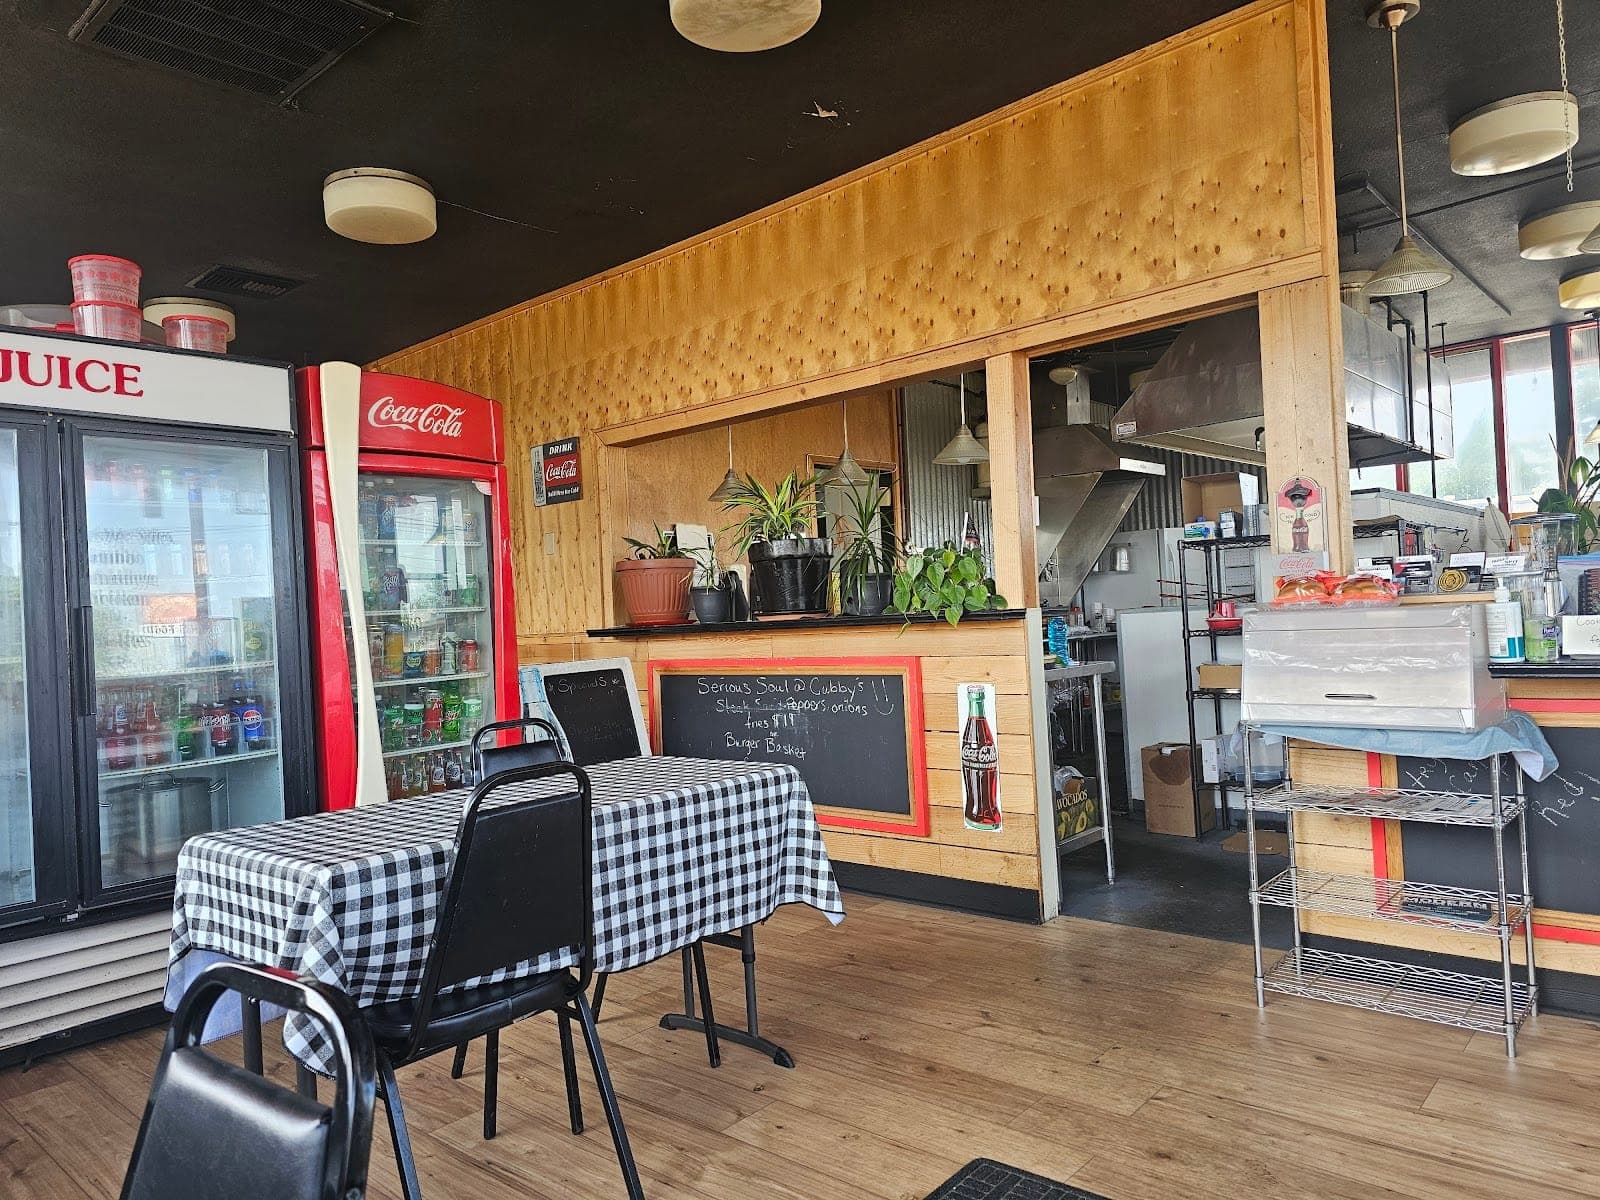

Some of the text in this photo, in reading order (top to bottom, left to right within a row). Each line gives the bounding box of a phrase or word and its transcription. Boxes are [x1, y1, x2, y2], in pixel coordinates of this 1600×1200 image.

[0, 348, 144, 397] JUICE
[367, 396, 467, 438] Coca-Cola
[549, 442, 573, 455] DRINK
[697, 676, 752, 695] Serious
[756, 676, 789, 695] Soul
[809, 676, 864, 702] Cubby's
[831, 698, 868, 716] onions
[724, 731, 806, 760] Burger Basket
[962, 743, 997, 762] Coca-Cola
